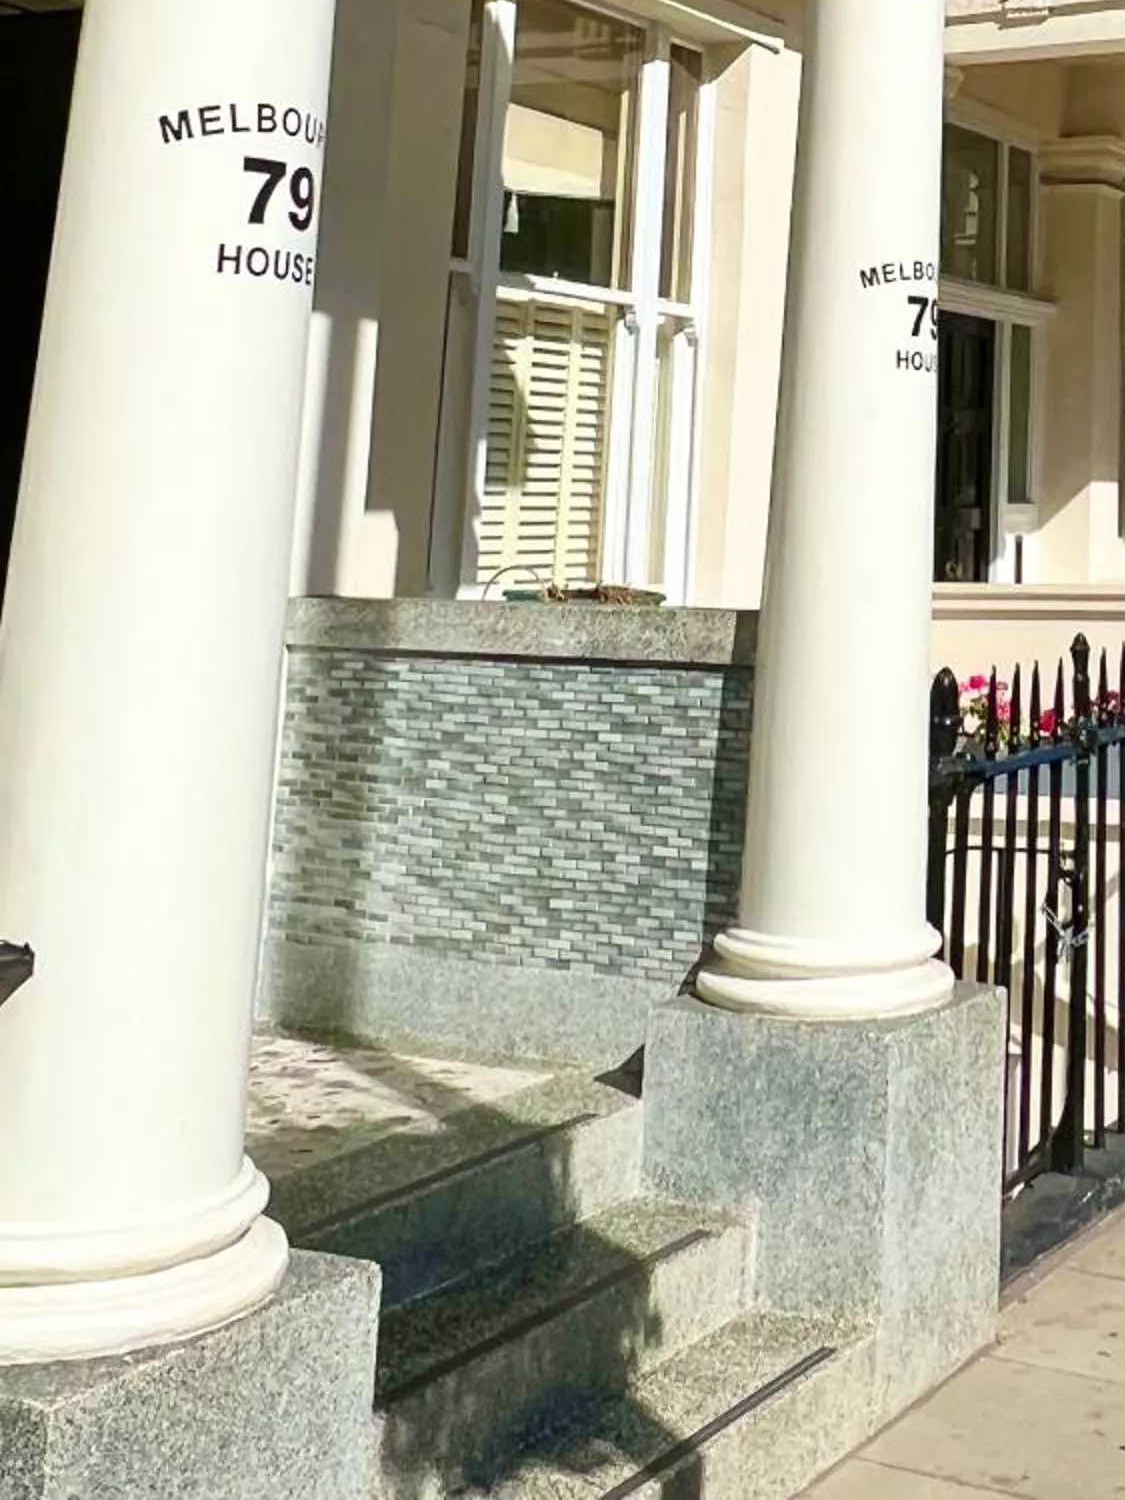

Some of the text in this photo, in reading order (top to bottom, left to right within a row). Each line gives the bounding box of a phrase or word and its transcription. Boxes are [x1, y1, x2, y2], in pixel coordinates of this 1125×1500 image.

[243, 155, 315, 232] 79
[217, 242, 313, 285] HOUSE
[859, 260, 938, 288] MELBO
